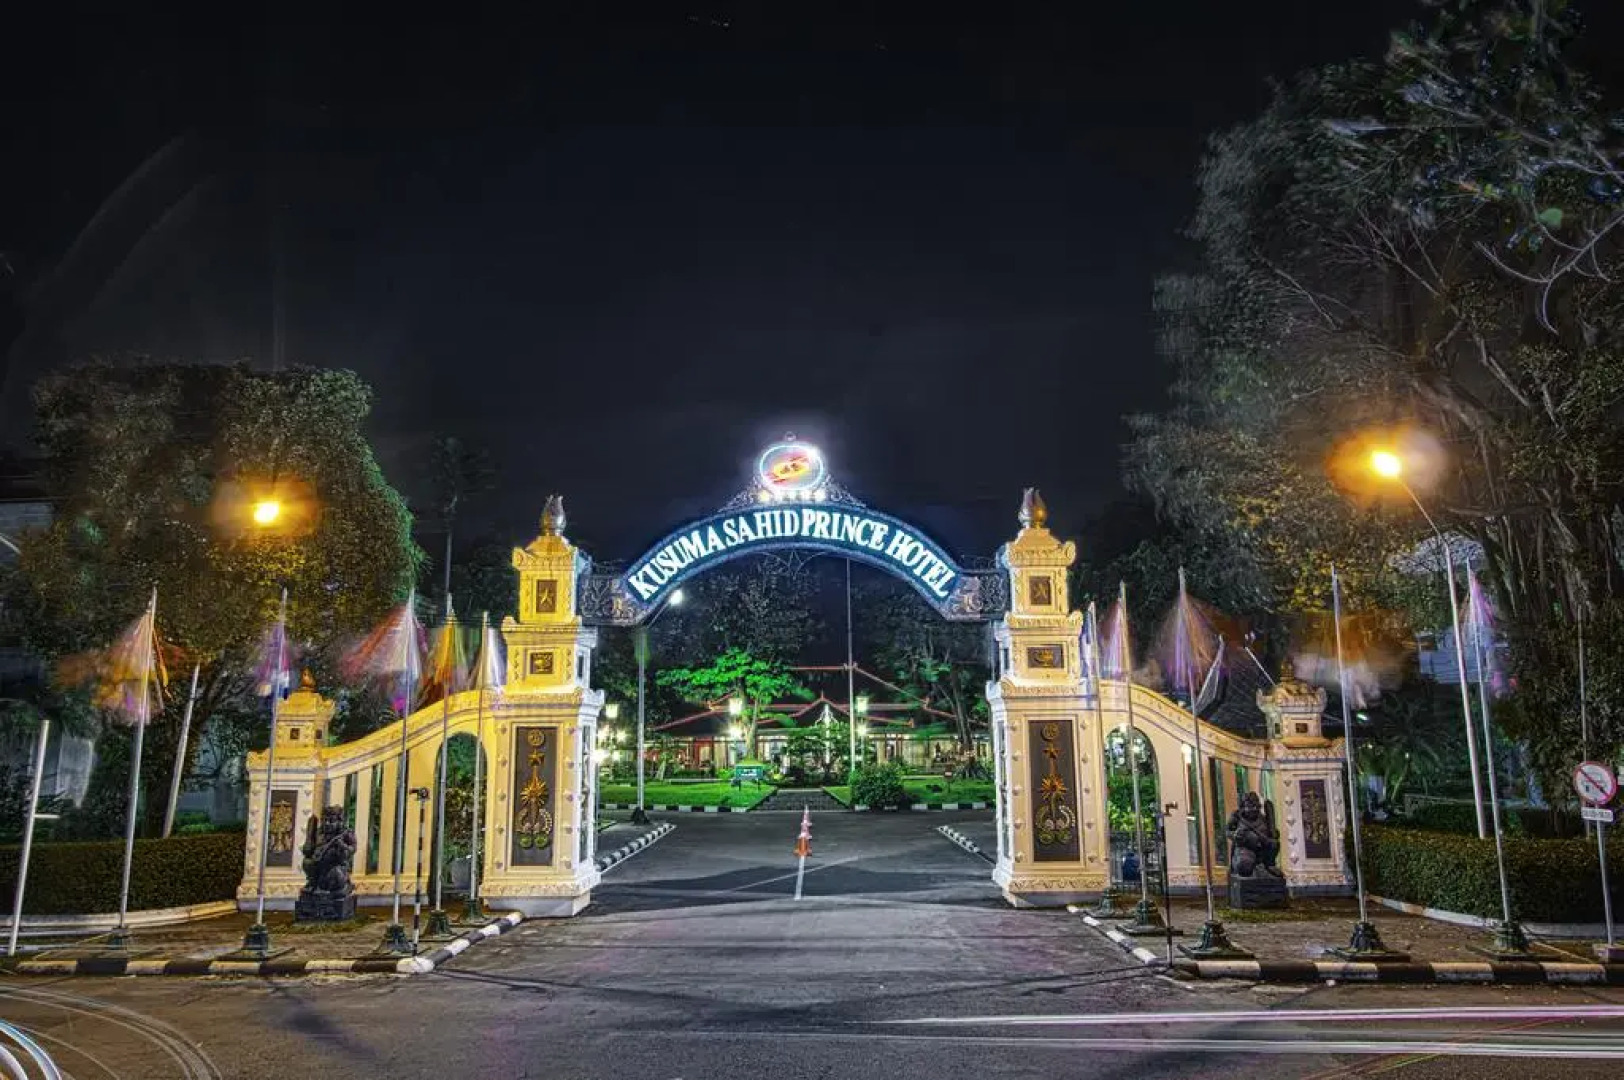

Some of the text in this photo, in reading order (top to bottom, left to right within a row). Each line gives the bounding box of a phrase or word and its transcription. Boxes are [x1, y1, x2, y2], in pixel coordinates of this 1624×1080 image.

[628, 508, 956, 600] KUSUMA SAHID PRINCE HOTEL
